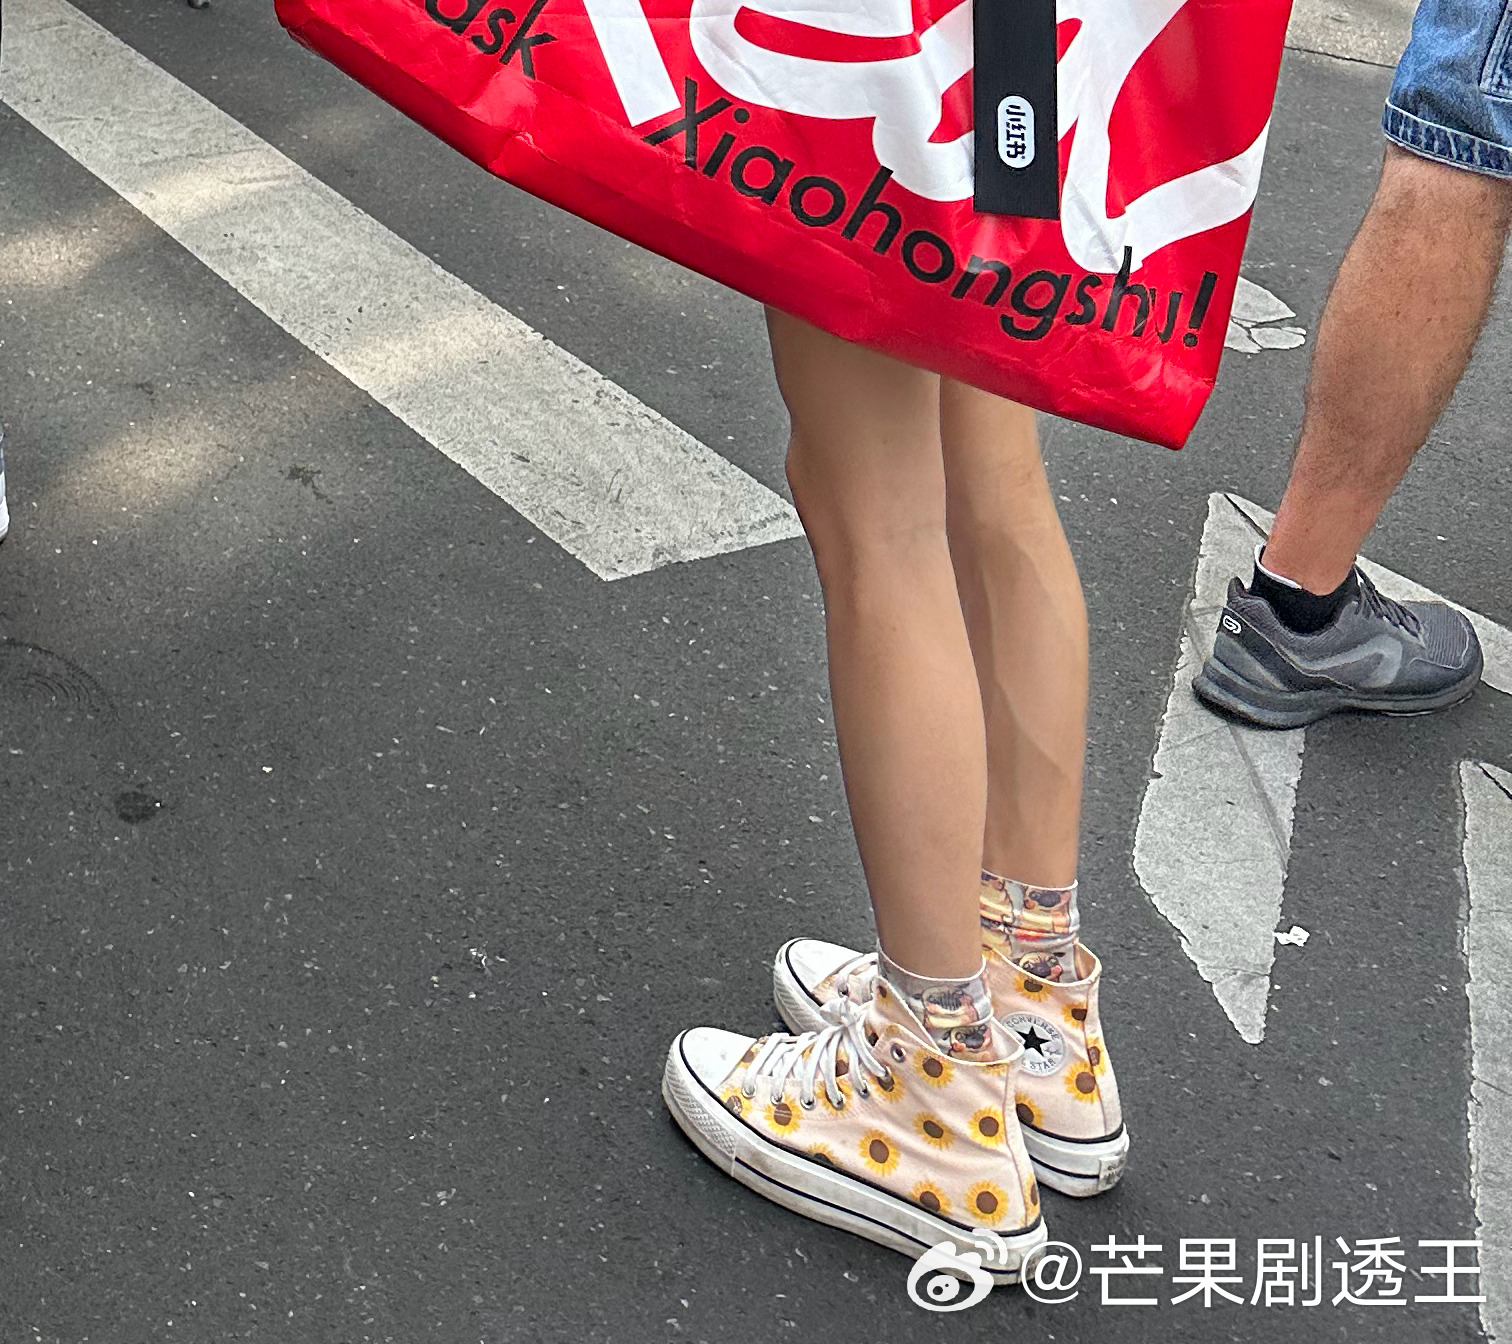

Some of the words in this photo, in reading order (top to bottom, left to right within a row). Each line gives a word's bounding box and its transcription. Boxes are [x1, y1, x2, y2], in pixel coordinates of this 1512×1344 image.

[642, 75, 1218, 350] Xiaohongshu!
[1005, 104, 1027, 160] 小红书
